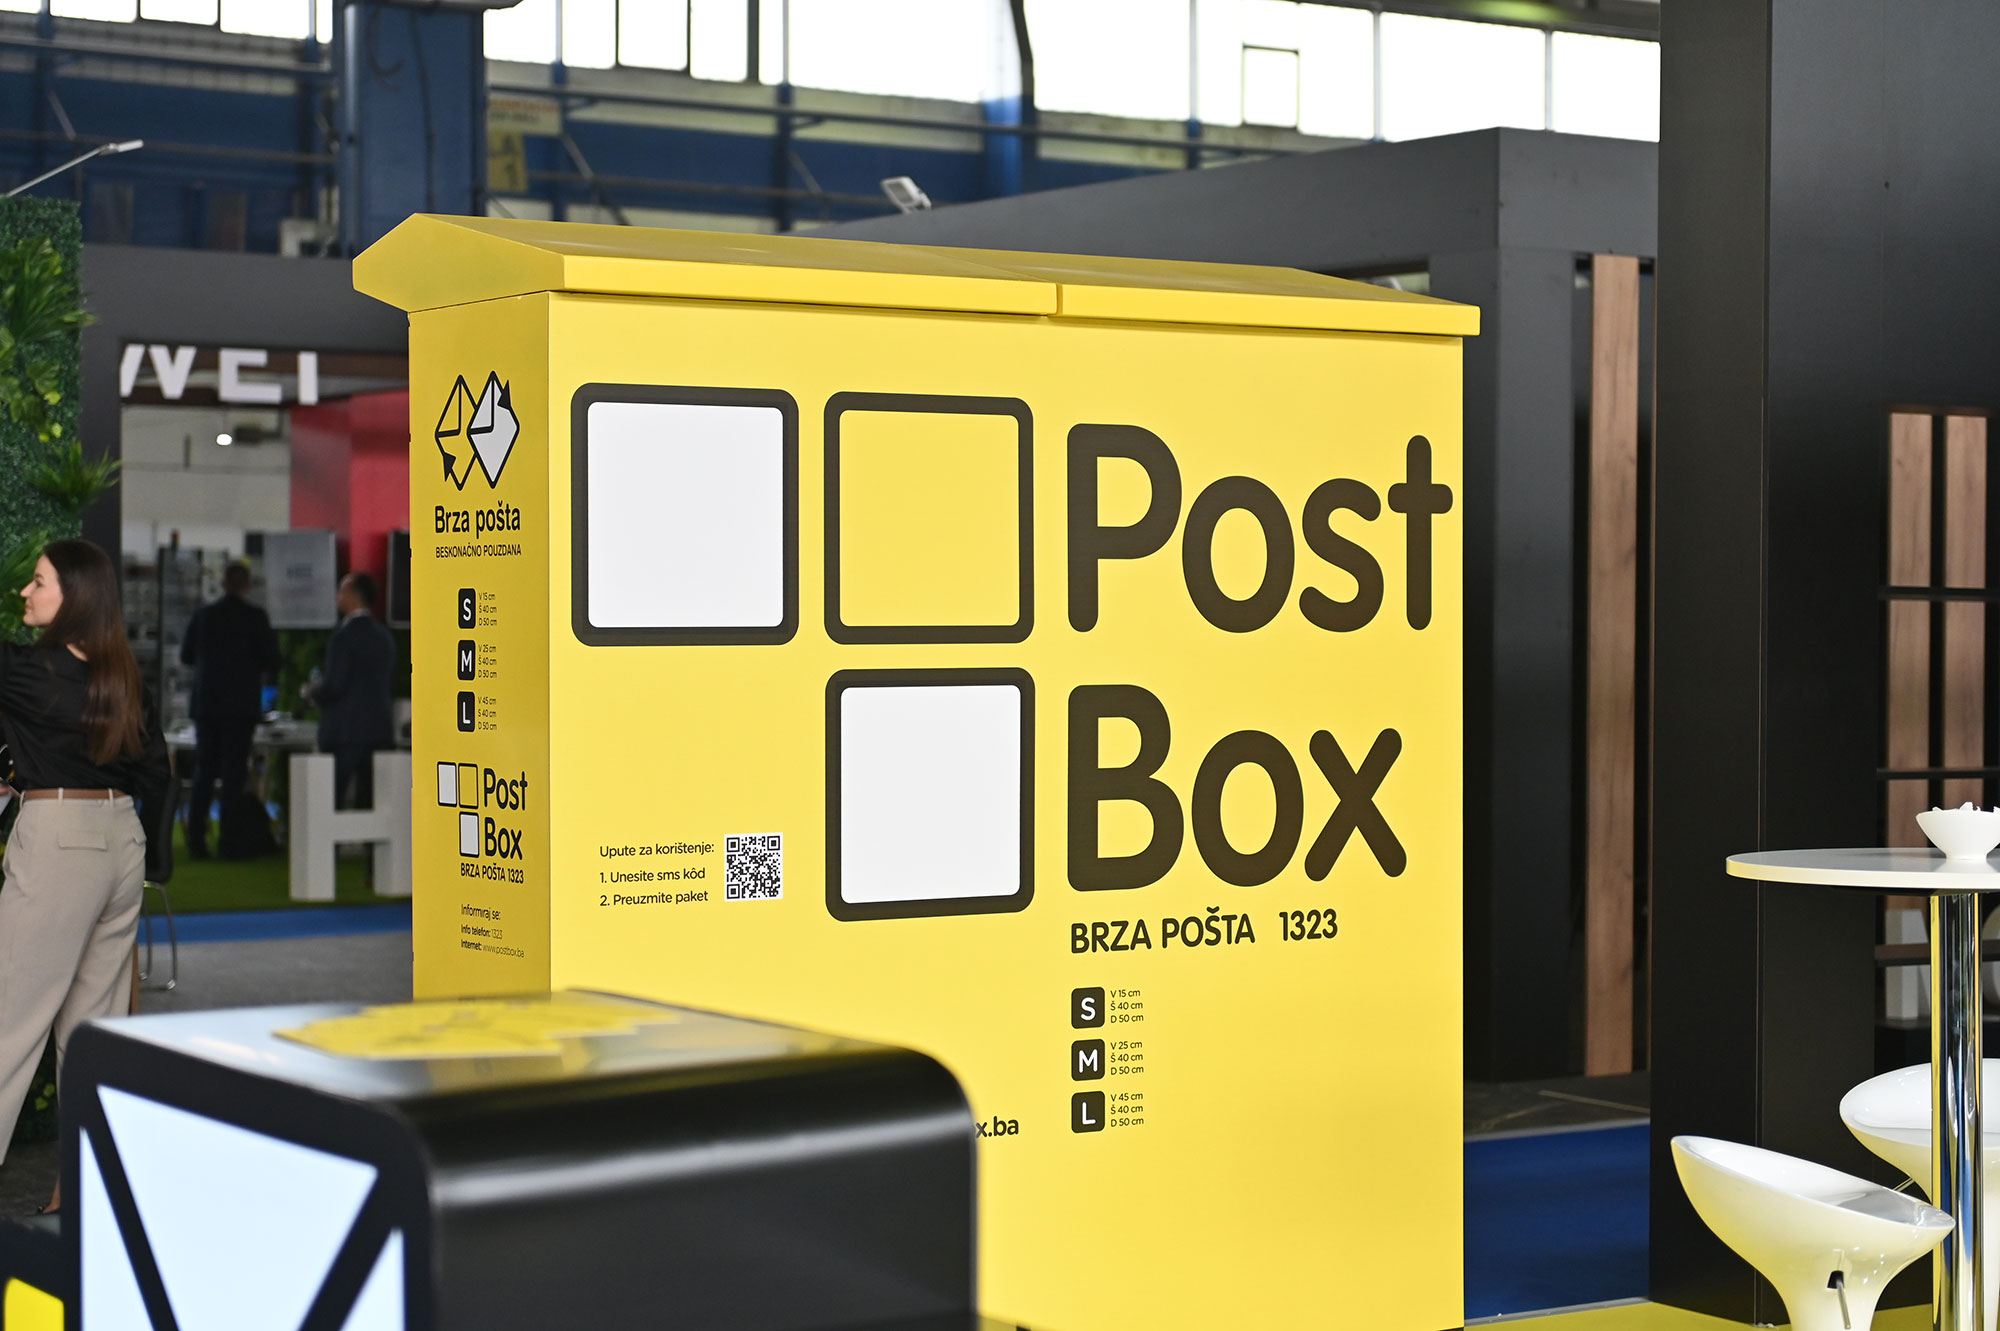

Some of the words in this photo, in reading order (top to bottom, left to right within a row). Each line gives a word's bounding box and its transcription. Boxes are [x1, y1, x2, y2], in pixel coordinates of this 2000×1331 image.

[434, 506, 470, 534] Brza
[476, 501, 520, 539] pošta
[1067, 424, 1453, 633] Post
[436, 542, 482, 558] BESKONAČNO
[484, 544, 522, 556] POUZDANA
[462, 598, 472, 620] S
[462, 650, 472, 672] M
[462, 702, 470, 724] L
[484, 768, 527, 810] Post
[1068, 685, 1406, 891] Box
[485, 817, 522, 860] Box
[600, 846, 636, 859] Upute
[638, 846, 652, 856] za
[656, 842, 714, 855] korištenje:
[460, 862, 480, 878] BRZA
[482, 862, 506, 882] POŠTA
[508, 868, 524, 884] 1323
[600, 872, 607, 883] 1.
[611, 871, 654, 882] Unesite
[656, 872, 680, 880] sms
[684, 868, 705, 879] kôd
[600, 895, 609, 906] 2.
[614, 892, 672, 905] Preuzmite
[676, 891, 708, 904] paket
[462, 904, 490, 920] Informiraj
[492, 910, 500, 920] se:
[1072, 919, 1151, 953] BRZA
[1162, 906, 1255, 948] POŠTA
[1279, 909, 1337, 941] 1323
[1110, 990, 1116, 998] V
[1118, 990, 1126, 998] 15
[1128, 990, 1140, 998] cm
[1081, 998, 1095, 1020] S
[1110, 1000, 1116, 1012] Š
[1118, 1002, 1130, 1010] 40
[1110, 1014, 1118, 1024] D
[1118, 1014, 1130, 1022] 50
[1130, 1014, 1144, 1022] cm
[1110, 1042, 1116, 1050] V
[1118, 1040, 1128, 1050] 25
[1079, 1049, 1097, 1072] M
[1110, 1052, 1116, 1062] Š
[1118, 1054, 1130, 1062] 40
[1130, 1054, 1144, 1062] cm
[1110, 1066, 1118, 1076] D
[1118, 1066, 1130, 1074] 50
[1110, 1094, 1116, 1102] V
[1118, 1092, 1130, 1102] 45
[1083, 1102, 1095, 1124] L
[1110, 1104, 1116, 1114] Š
[1118, 1104, 1130, 1114] 40
[1130, 1106, 1144, 1114] cm
[1110, 1118, 1118, 1128] D
[1118, 1118, 1130, 1126] 50
[1132, 1118, 1144, 1126] cm
